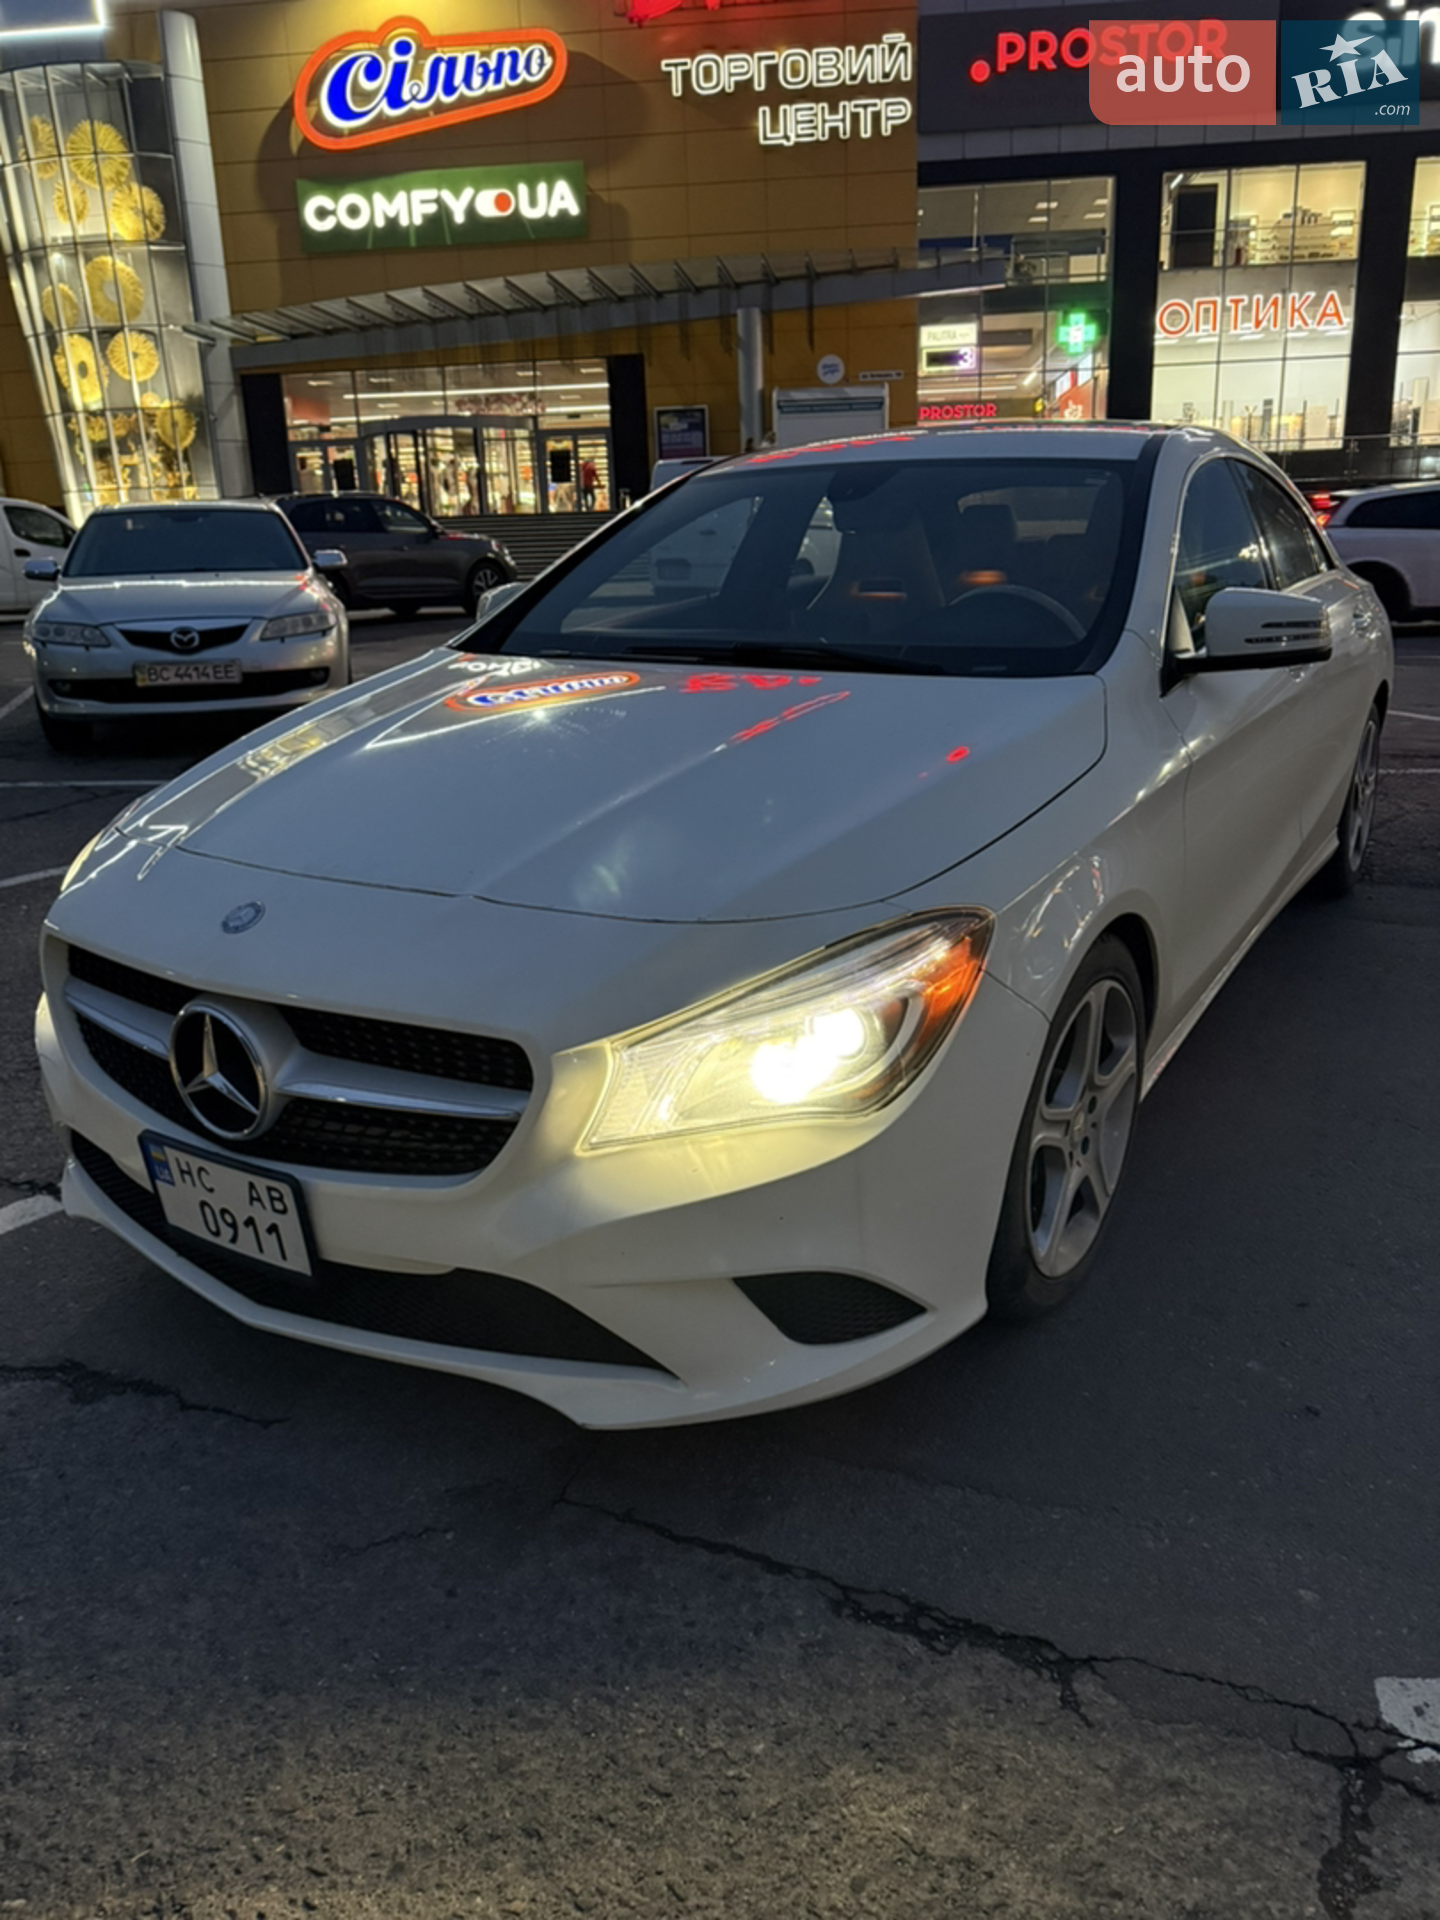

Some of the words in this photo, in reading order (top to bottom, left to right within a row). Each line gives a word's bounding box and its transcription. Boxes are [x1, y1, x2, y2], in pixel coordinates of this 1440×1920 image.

[661, 33, 912, 97] ТОРГОВИЙ
[995, 18, 1229, 73] PROSTOR
[321, 37, 552, 126] Сільпо
[758, 97, 912, 147] ЦЕНТР
[303, 186, 475, 232] COMFY
[516, 179, 581, 220] UA
[1156, 289, 1346, 338] ОПТИКА
[918, 401, 997, 420] PROSTOR
[147, 665, 171, 682] BC
[174, 664, 211, 681] 4414
[212, 663, 236, 680] EE
[175, 1157, 215, 1194] HC
[248, 1180, 289, 1216] AB
[198, 1199, 288, 1262] 0911
